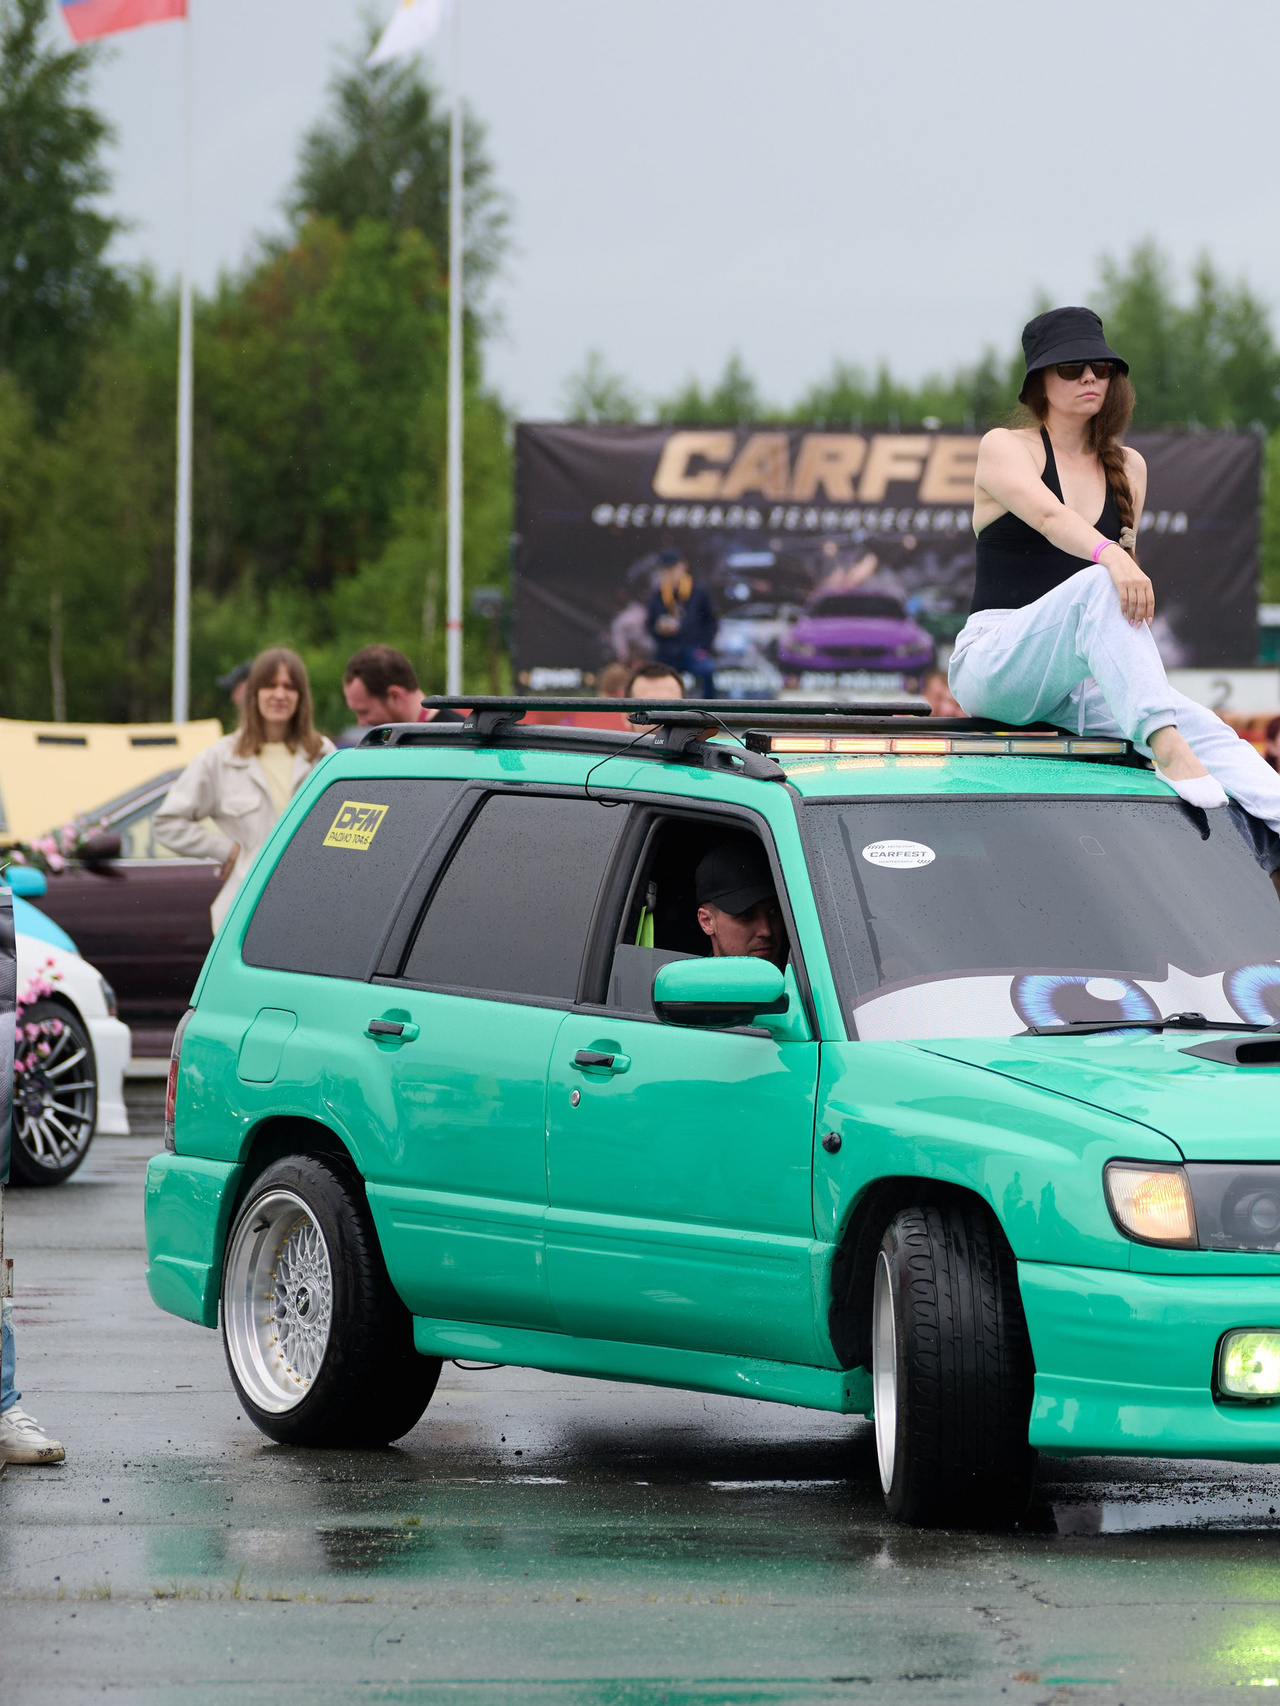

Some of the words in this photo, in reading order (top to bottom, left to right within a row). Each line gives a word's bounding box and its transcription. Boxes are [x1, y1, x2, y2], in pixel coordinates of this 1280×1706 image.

[651, 431, 980, 503] CARFE
[1139, 510, 1188, 534] РТА
[334, 806, 384, 833] DFM
[328, 831, 353, 844] РАДИО
[869, 850, 928, 858] CARFEST
